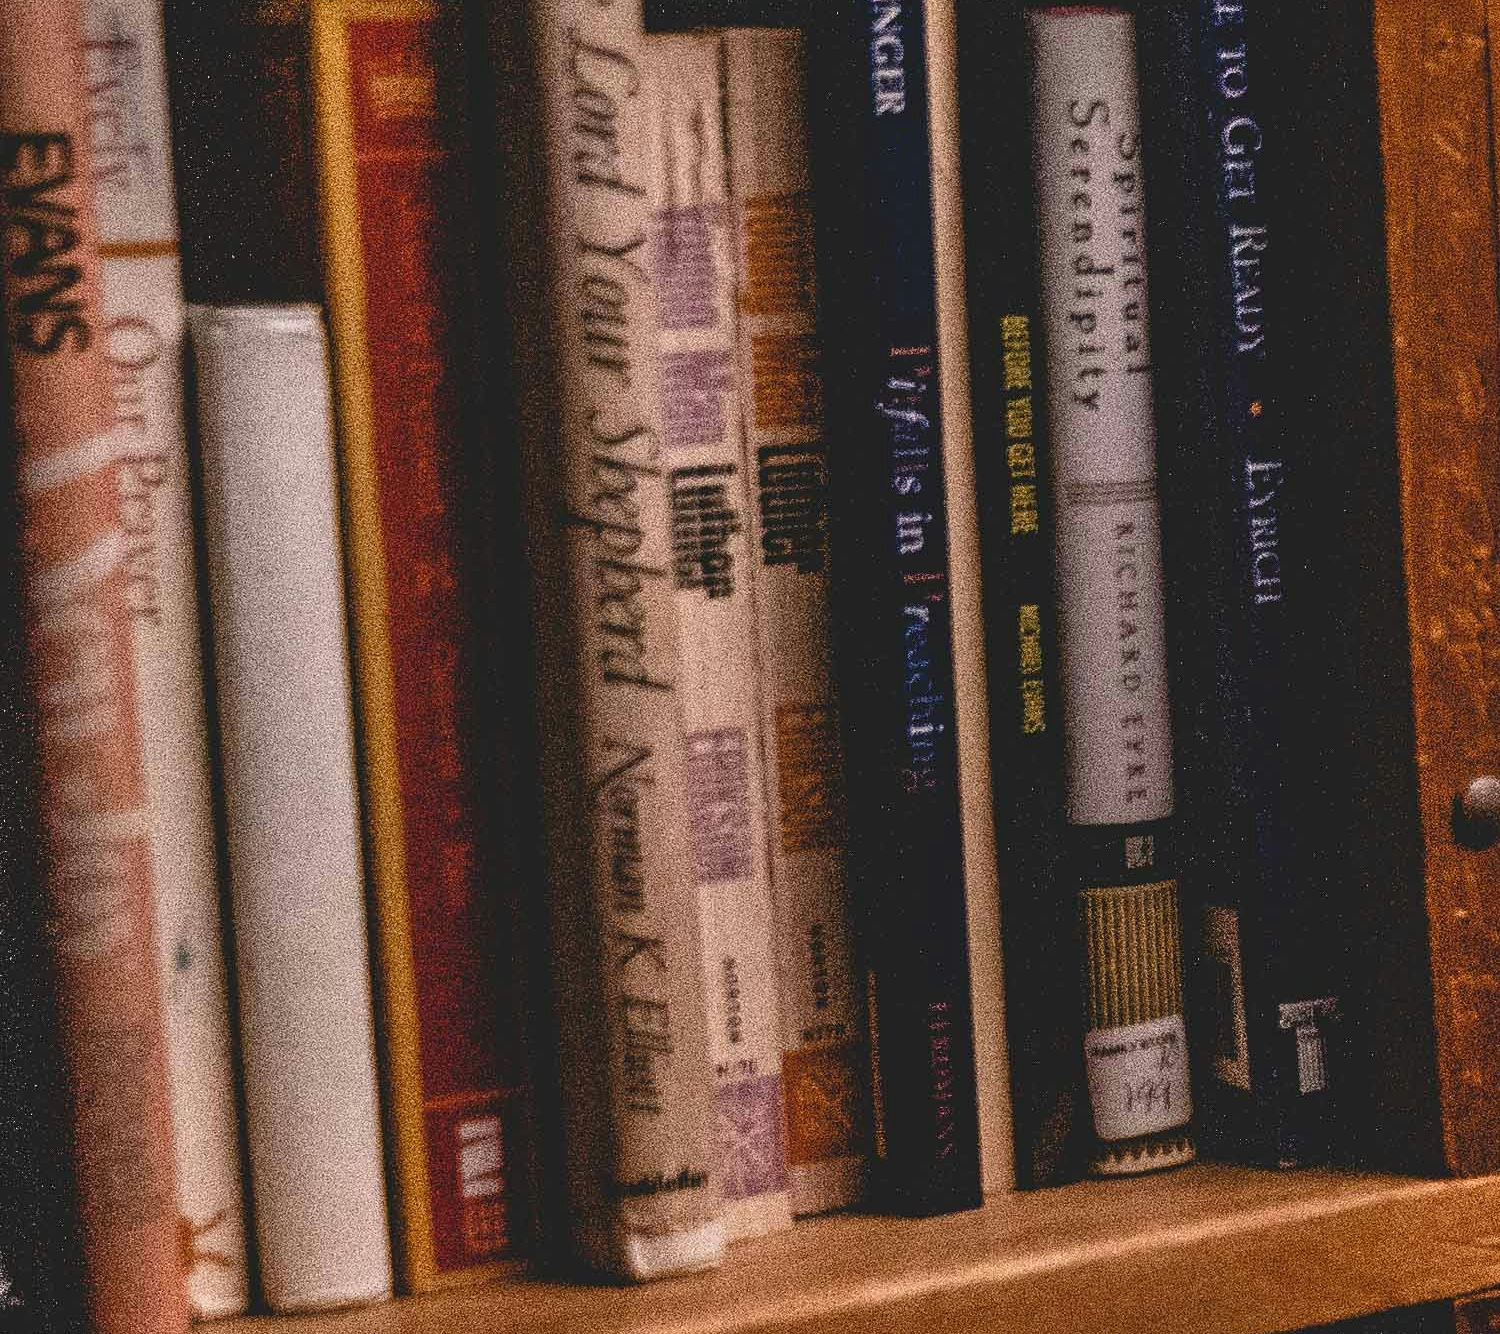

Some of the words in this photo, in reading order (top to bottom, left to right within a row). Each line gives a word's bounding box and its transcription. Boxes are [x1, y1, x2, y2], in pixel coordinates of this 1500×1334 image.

[1216, 43, 1252, 99] TO
[1216, 118, 1260, 203] GET
[8, 130, 91, 357] EVANS
[579, 238, 650, 386] Your
[1063, 98, 1110, 415] Serendipity
[1227, 222, 1271, 358] READY
[560, 413, 672, 694] Shepherd
[1244, 457, 1287, 607] EYRICH
